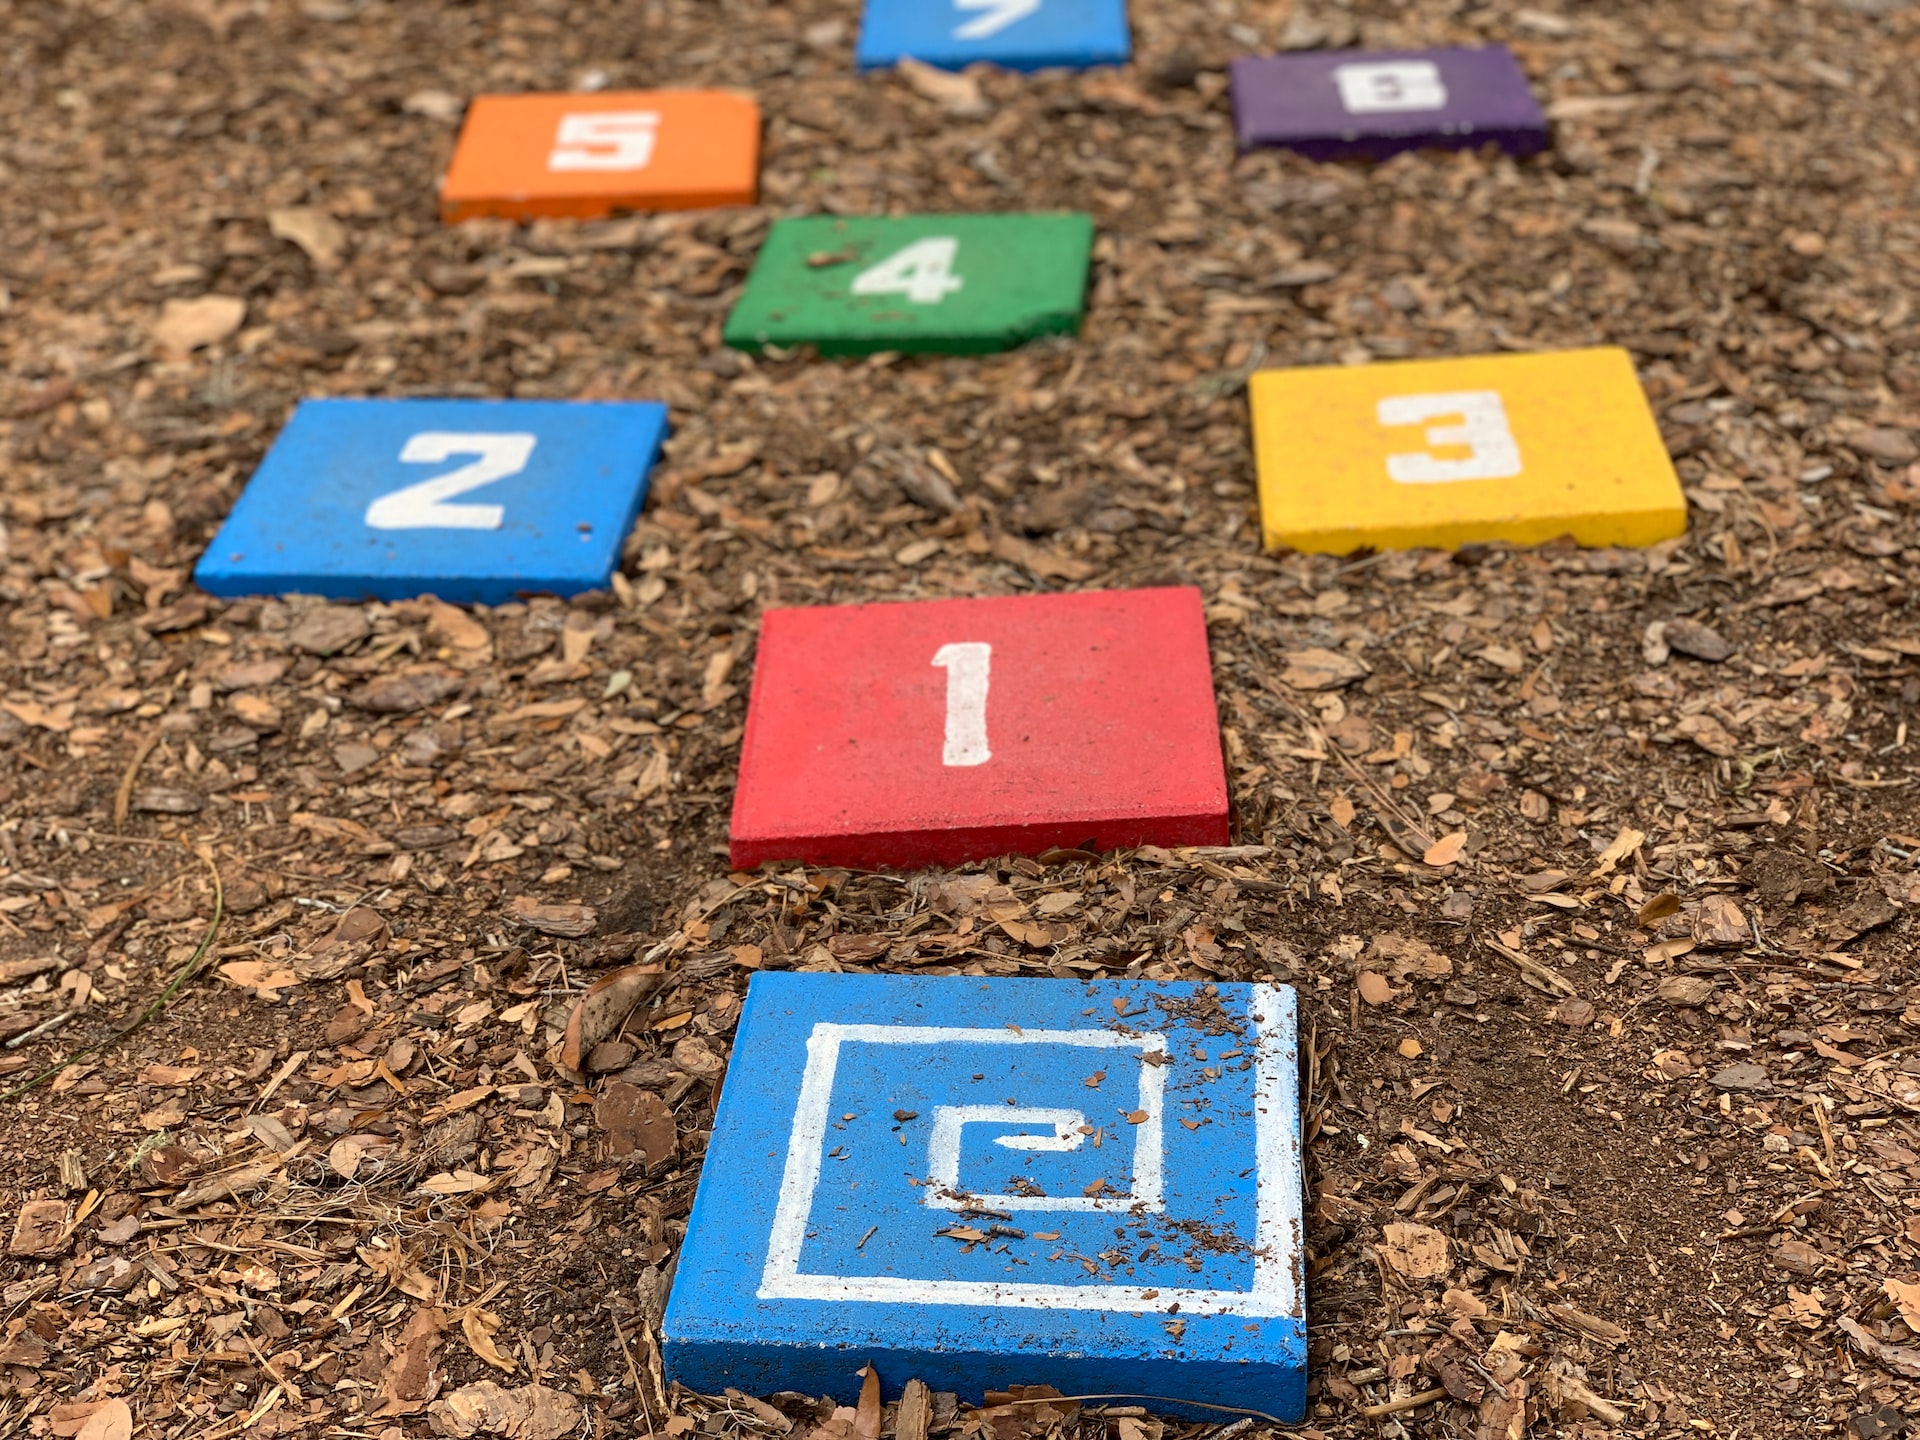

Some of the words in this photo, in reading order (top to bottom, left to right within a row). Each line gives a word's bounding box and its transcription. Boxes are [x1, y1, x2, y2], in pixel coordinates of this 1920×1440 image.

[548, 111, 658, 171] 5
[850, 235, 964, 305] 4
[366, 432, 537, 530] 2
[1377, 391, 1522, 483] 3
[932, 642, 992, 767] 1
